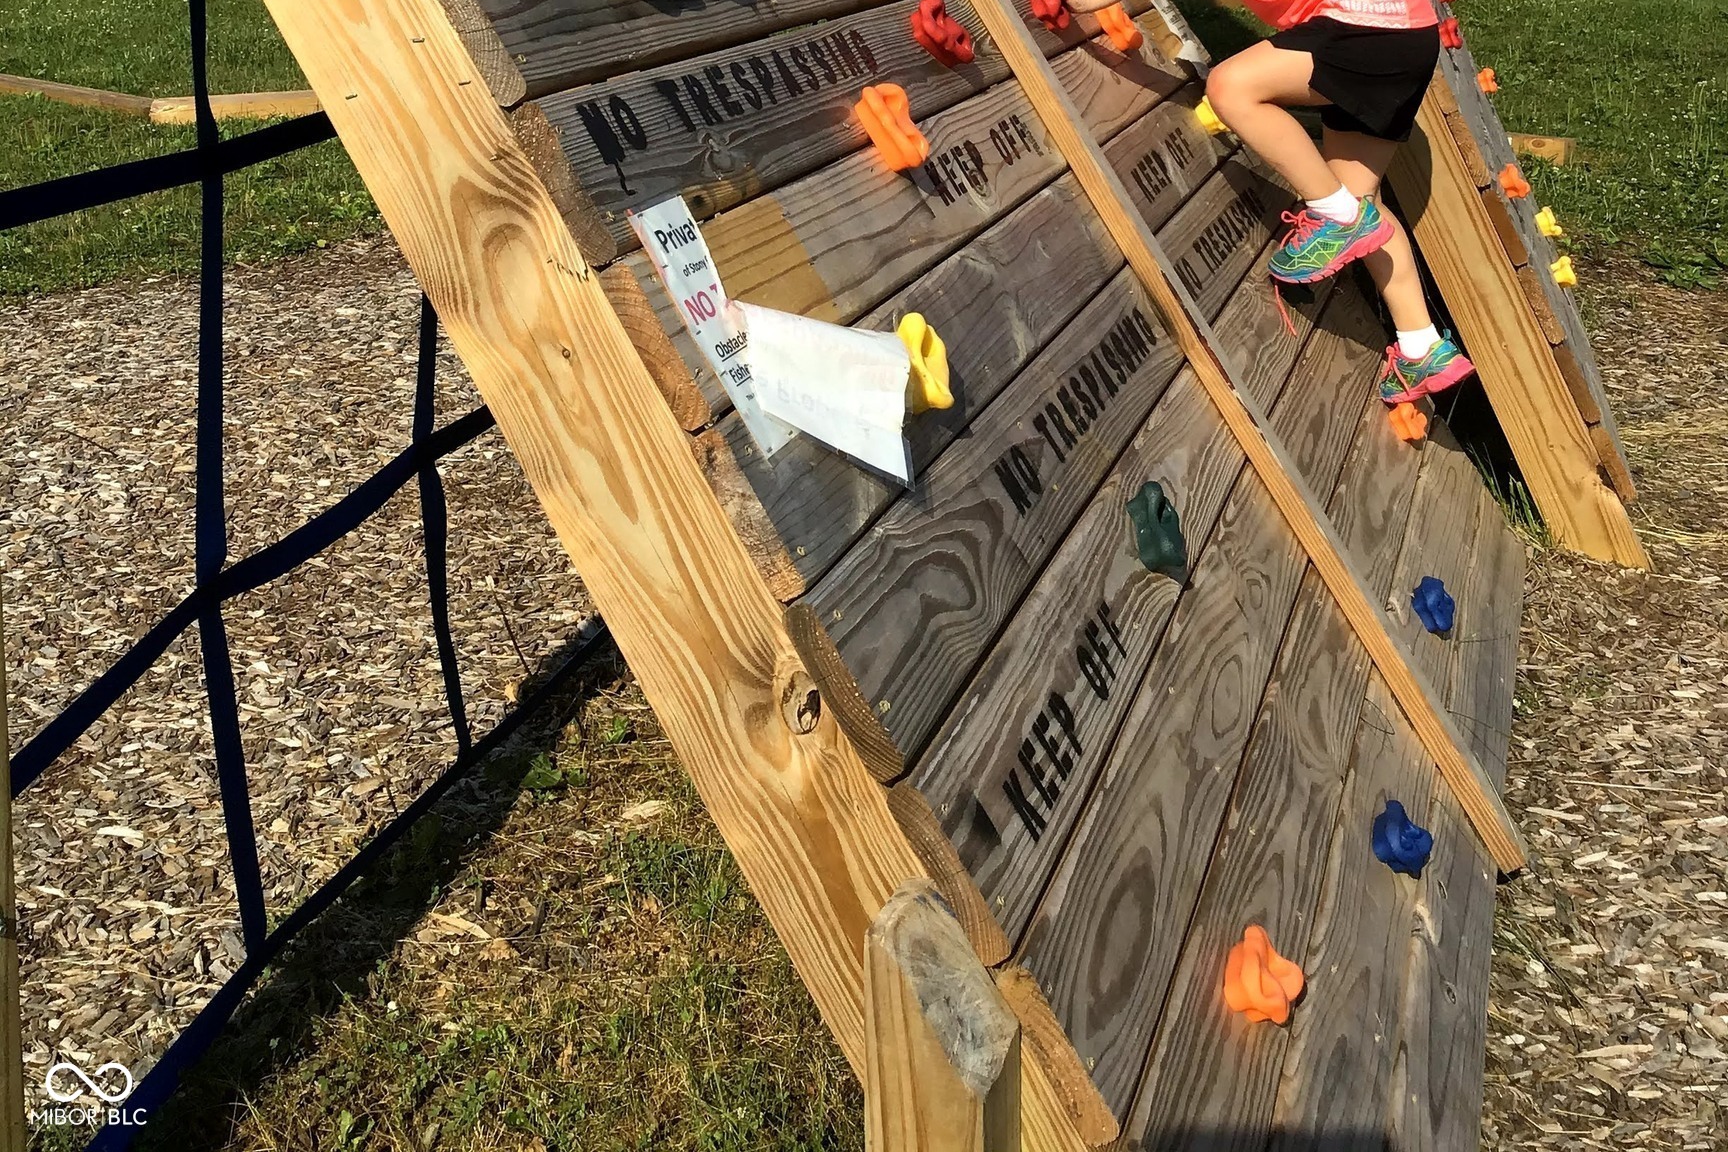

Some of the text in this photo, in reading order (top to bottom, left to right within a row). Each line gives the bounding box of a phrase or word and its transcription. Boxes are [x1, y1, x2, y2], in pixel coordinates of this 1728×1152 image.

[577, 29, 878, 166] NO TRESPASSING
[924, 114, 1032, 207] KEEP OFF
[1131, 127, 1194, 202] KEEP OFF
[684, 291, 716, 325] NO
[689, 259, 708, 274] Stony
[1173, 257, 1203, 302] NO
[995, 307, 1157, 519] NO TRESPASSING
[1003, 601, 1127, 842] KEEP OFF
